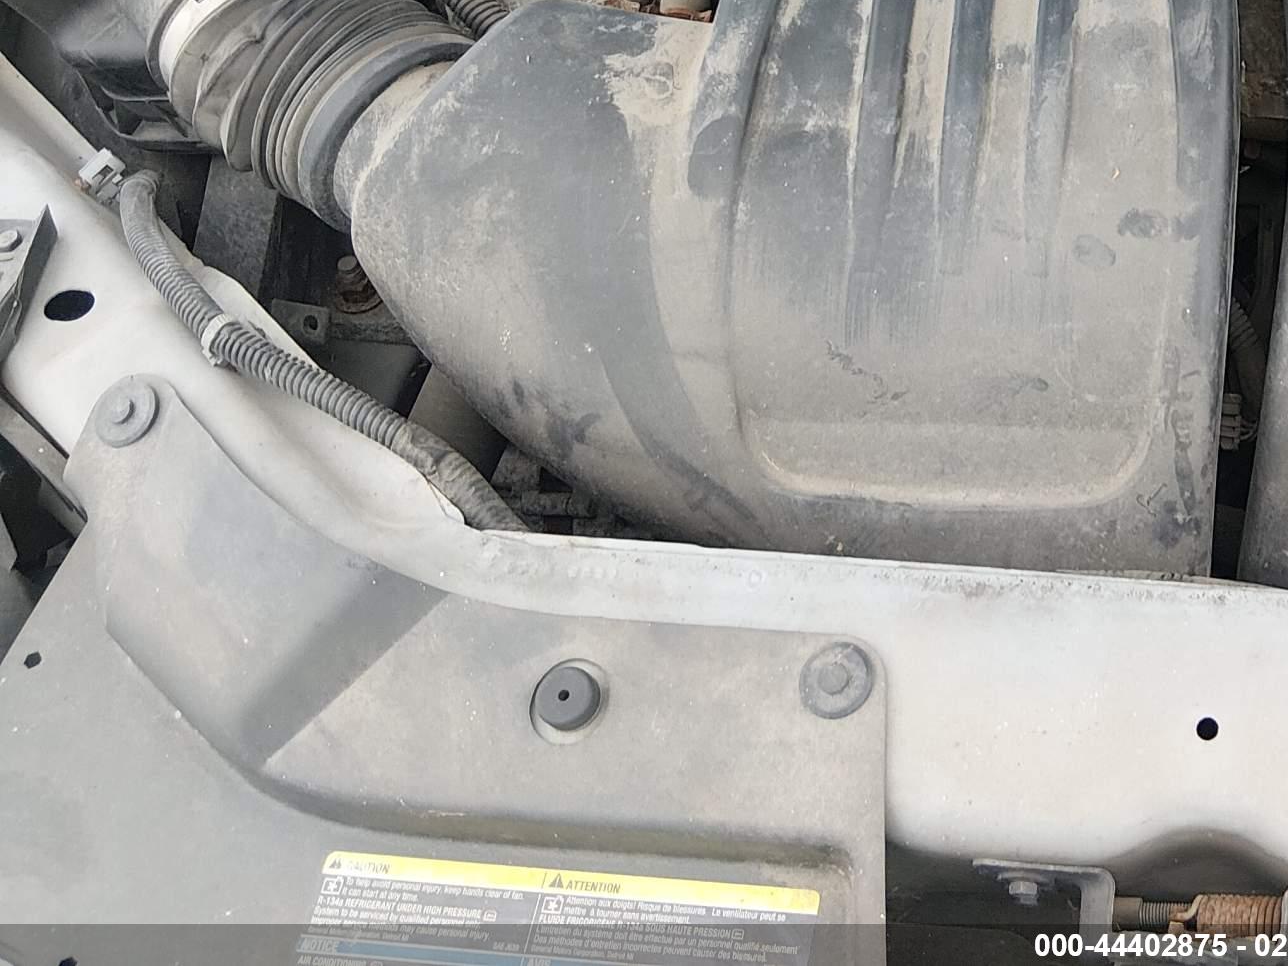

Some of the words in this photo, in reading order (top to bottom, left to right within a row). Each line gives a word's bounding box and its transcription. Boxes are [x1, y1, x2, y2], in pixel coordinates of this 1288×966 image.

[348, 888, 360, 896] can
[379, 889, 387, 898] at
[391, 880, 420, 893] personal
[444, 884, 459, 896] keep
[462, 886, 482, 896] hands
[503, 889, 510, 898] of
[564, 878, 620, 894] ATTENTION
[313, 905, 338, 917] System
[348, 908, 358, 917] be
[389, 911, 397, 922] by
[344, 898, 396, 911] REFRIGERANT
[397, 902, 422, 913] UNDER
[423, 904, 442, 914] HIGH
[442, 905, 481, 917] PRESSURE
[565, 896, 596, 906] Attention
[758, 911, 775, 922] peut
[437, 925, 468, 937] personal
[538, 914, 564, 925] FLUIDE
[644, 922, 664, 933] SOUS
[667, 924, 690, 935] HAUTE
[693, 926, 731, 938] PRESSION
[300, 938, 338, 953] NOTICE
[533, 934, 546, 944] Des
[622, 941, 661, 953] incorrectes
[662, 946, 691, 957] peuvent
[692, 948, 715, 957] causer
[717, 949, 730, 958] des
[572, 927, 582, 937] du
[674, 937, 685, 947] par
[687, 938, 696, 946] un
[698, 937, 733, 950] personnel
[297, 954, 310, 966] AIR
